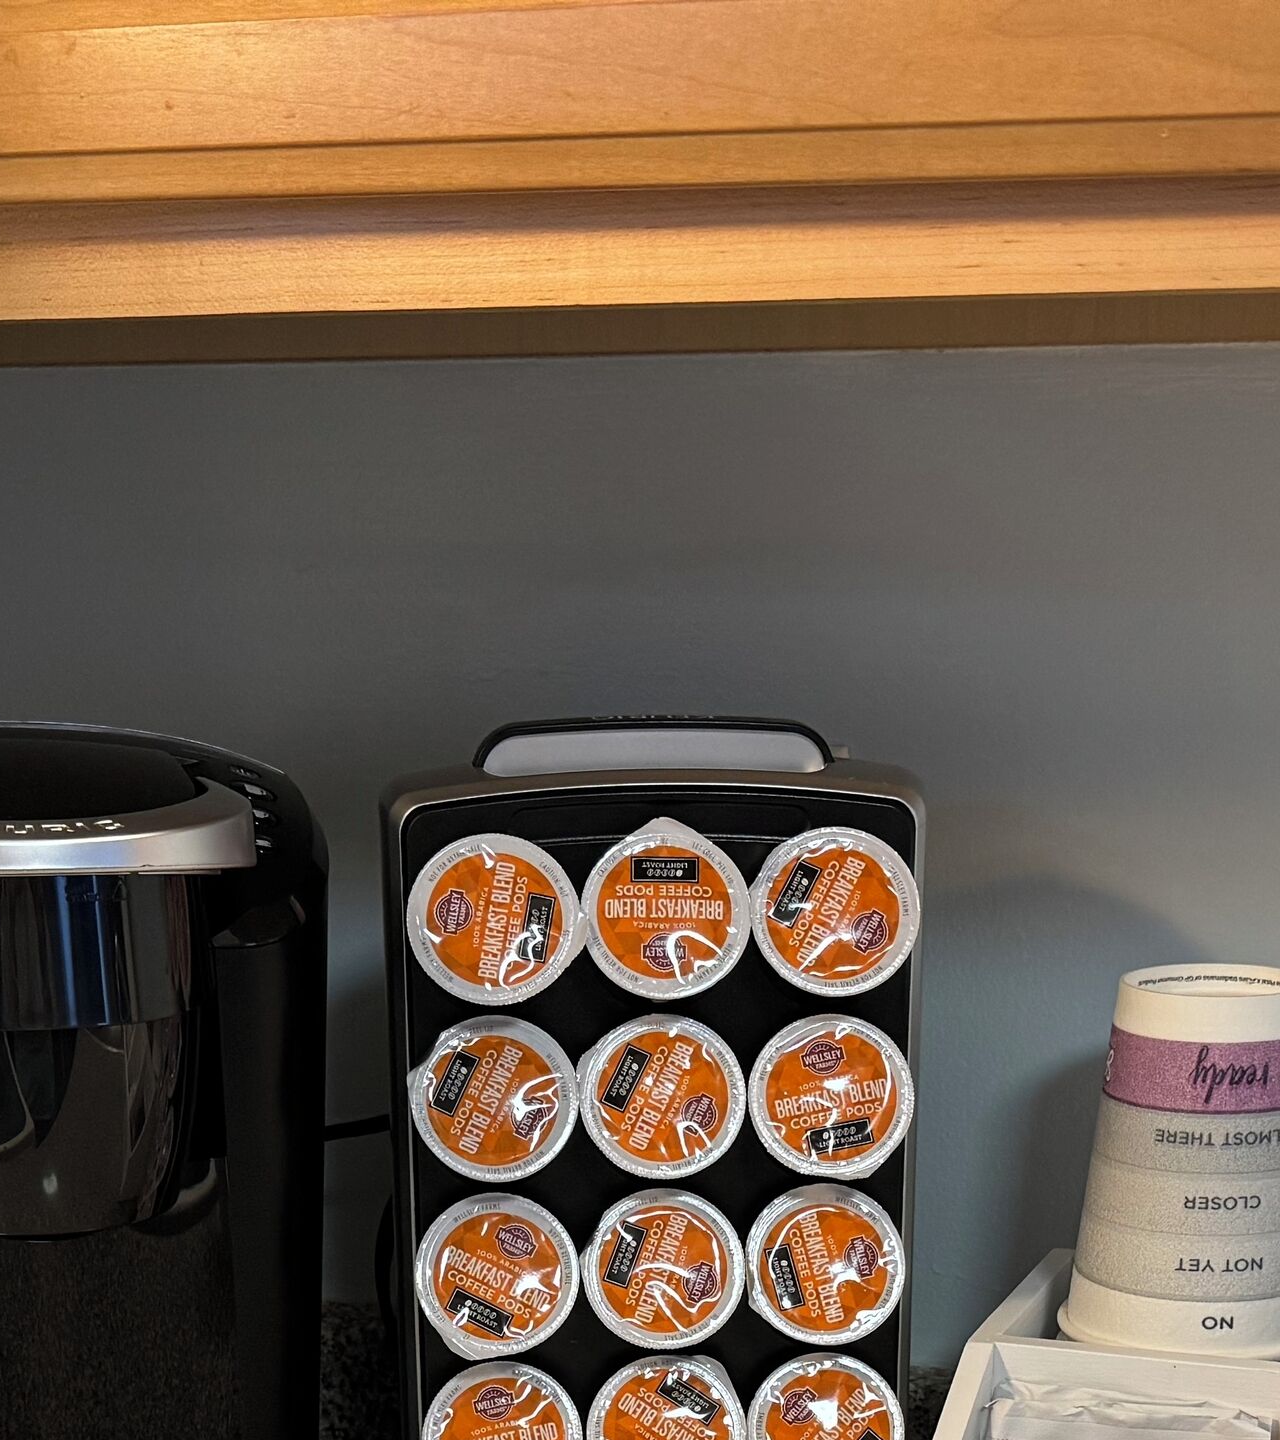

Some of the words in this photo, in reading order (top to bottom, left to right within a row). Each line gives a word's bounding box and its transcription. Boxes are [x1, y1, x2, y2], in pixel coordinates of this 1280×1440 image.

[490, 860, 516, 904] BLEND
[511, 875, 528, 912] PODS
[615, 884, 653, 895] PODS
[659, 884, 711, 896] COFFEE
[815, 855, 865, 927] BREAKFAST
[445, 891, 462, 932] WELLSLEY
[475, 886, 489, 922] ARABICA
[604, 898, 645, 918] BLEND
[650, 898, 723, 919] BREAKFAST
[477, 904, 508, 978] BREAKFAST
[632, 920, 669, 928] ARABICA
[788, 909, 814, 948] PODS
[856, 911, 881, 951] WELLSLEY
[467, 1048, 497, 1098] COFFEE
[803, 1049, 841, 1065] WELLSLEY
[1189, 1046, 1270, 1103] ready
[475, 1044, 523, 1114] BREAKFAST
[449, 1098, 474, 1136] PODS
[619, 1094, 644, 1132] PODS
[658, 1095, 680, 1131] ARABICA
[845, 1101, 882, 1118] PODS
[457, 1111, 491, 1154] BLEND
[626, 1106, 661, 1151] BLEND
[1155, 1128, 1216, 1147] THERE
[1184, 1195, 1262, 1211] CLOSER
[496, 1229, 534, 1253] WELLSLEY
[638, 1218, 664, 1266] COFFEE
[852, 1238, 871, 1276] WELLSLEY
[443, 1245, 513, 1292] BREAKFAST
[690, 1263, 710, 1302] WELLSLEY
[787, 1228, 810, 1278] COFFEE
[802, 1280, 821, 1318] PODS
[797, 1212, 833, 1283] BREAKFAST
[816, 1281, 844, 1324] BLEND
[1174, 1257, 1214, 1273] YET
[1222, 1256, 1264, 1273] NOT
[445, 1268, 496, 1300] COFFEE
[495, 1294, 532, 1319] PODS
[624, 1270, 646, 1306] PODS
[1202, 1316, 1234, 1330] NO
[616, 1390, 658, 1427] BLEND
[636, 1385, 670, 1413] PODS
[783, 1390, 814, 1423] WELLSLEY
